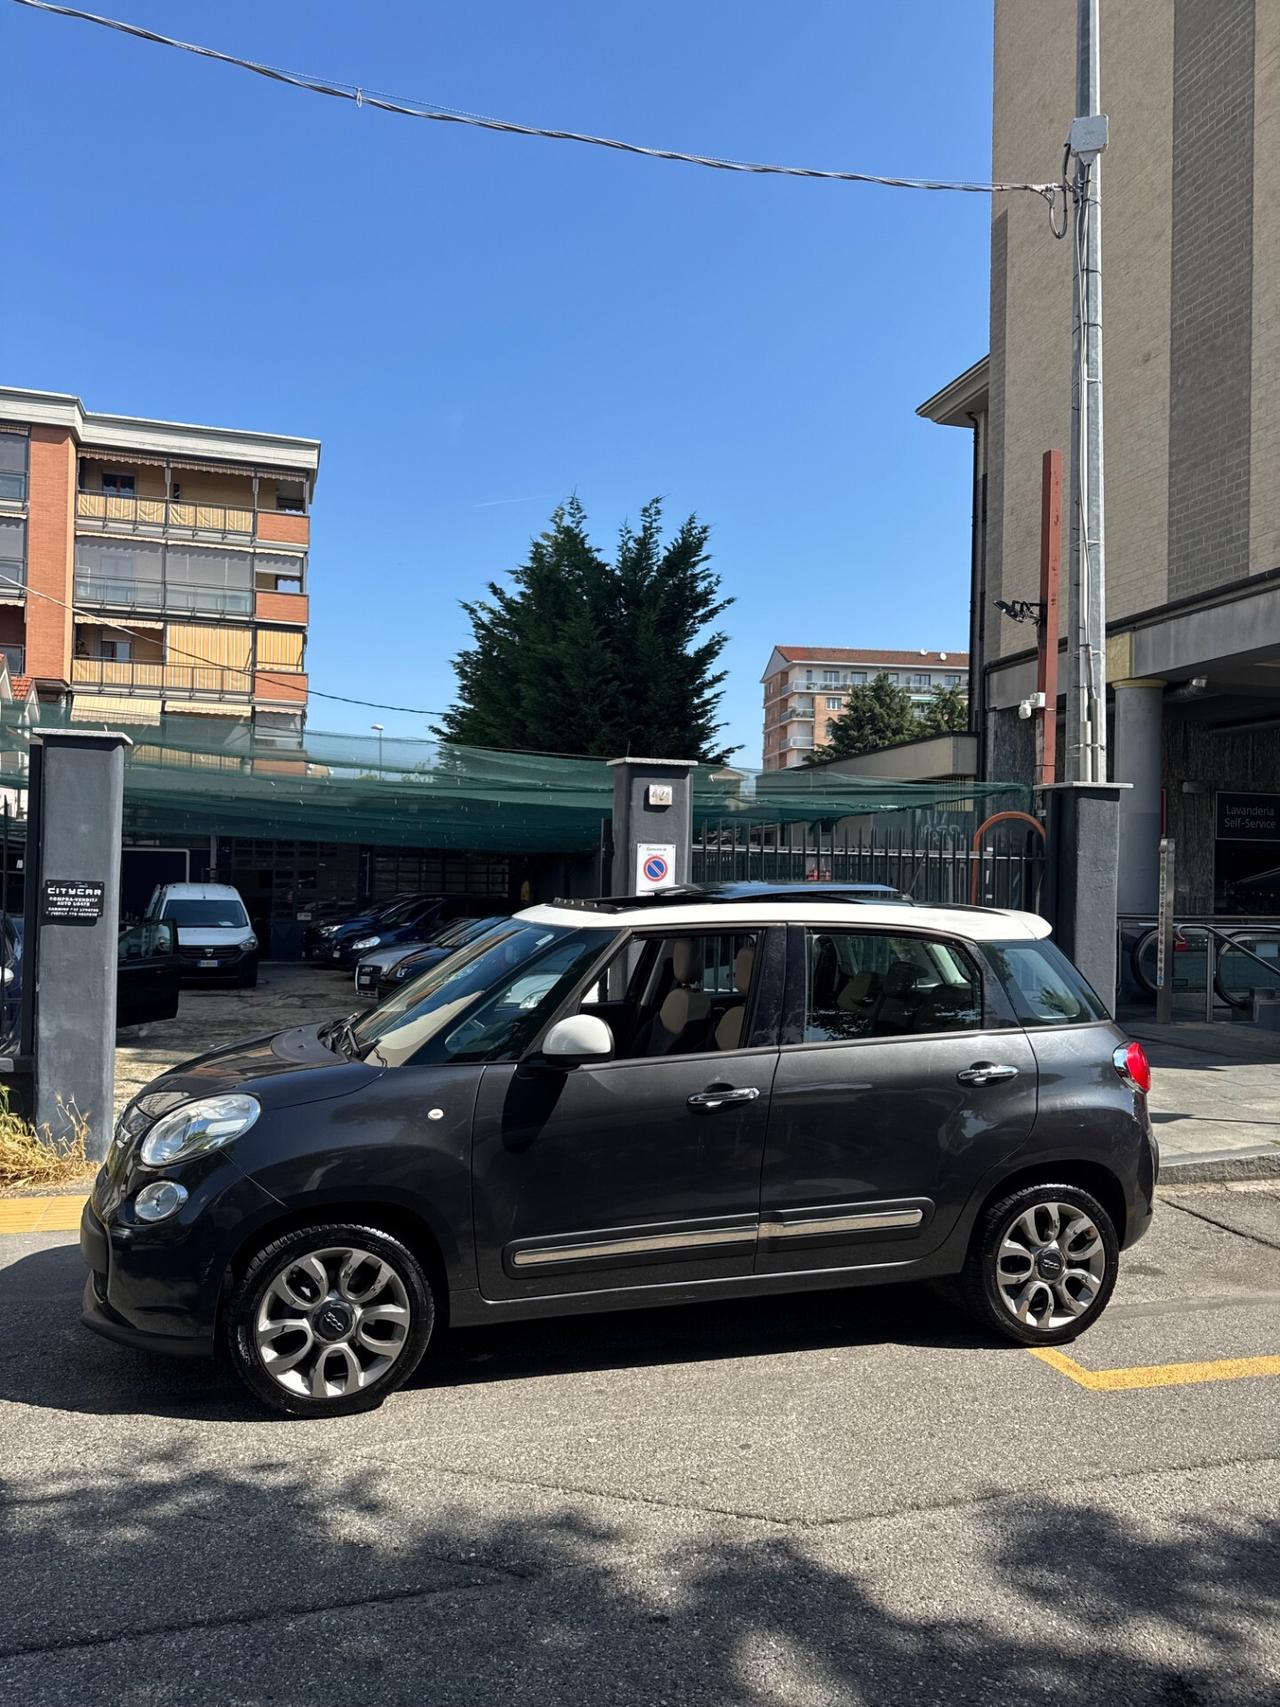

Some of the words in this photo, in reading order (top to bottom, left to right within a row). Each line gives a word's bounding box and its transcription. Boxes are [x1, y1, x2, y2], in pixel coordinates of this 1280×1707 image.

[1226, 804, 1274, 816] Lavanderia
[1224, 817, 1277, 829] Self-Service
[47, 886, 102, 896] CITYCAR
[323, 1311, 345, 1332] 500
